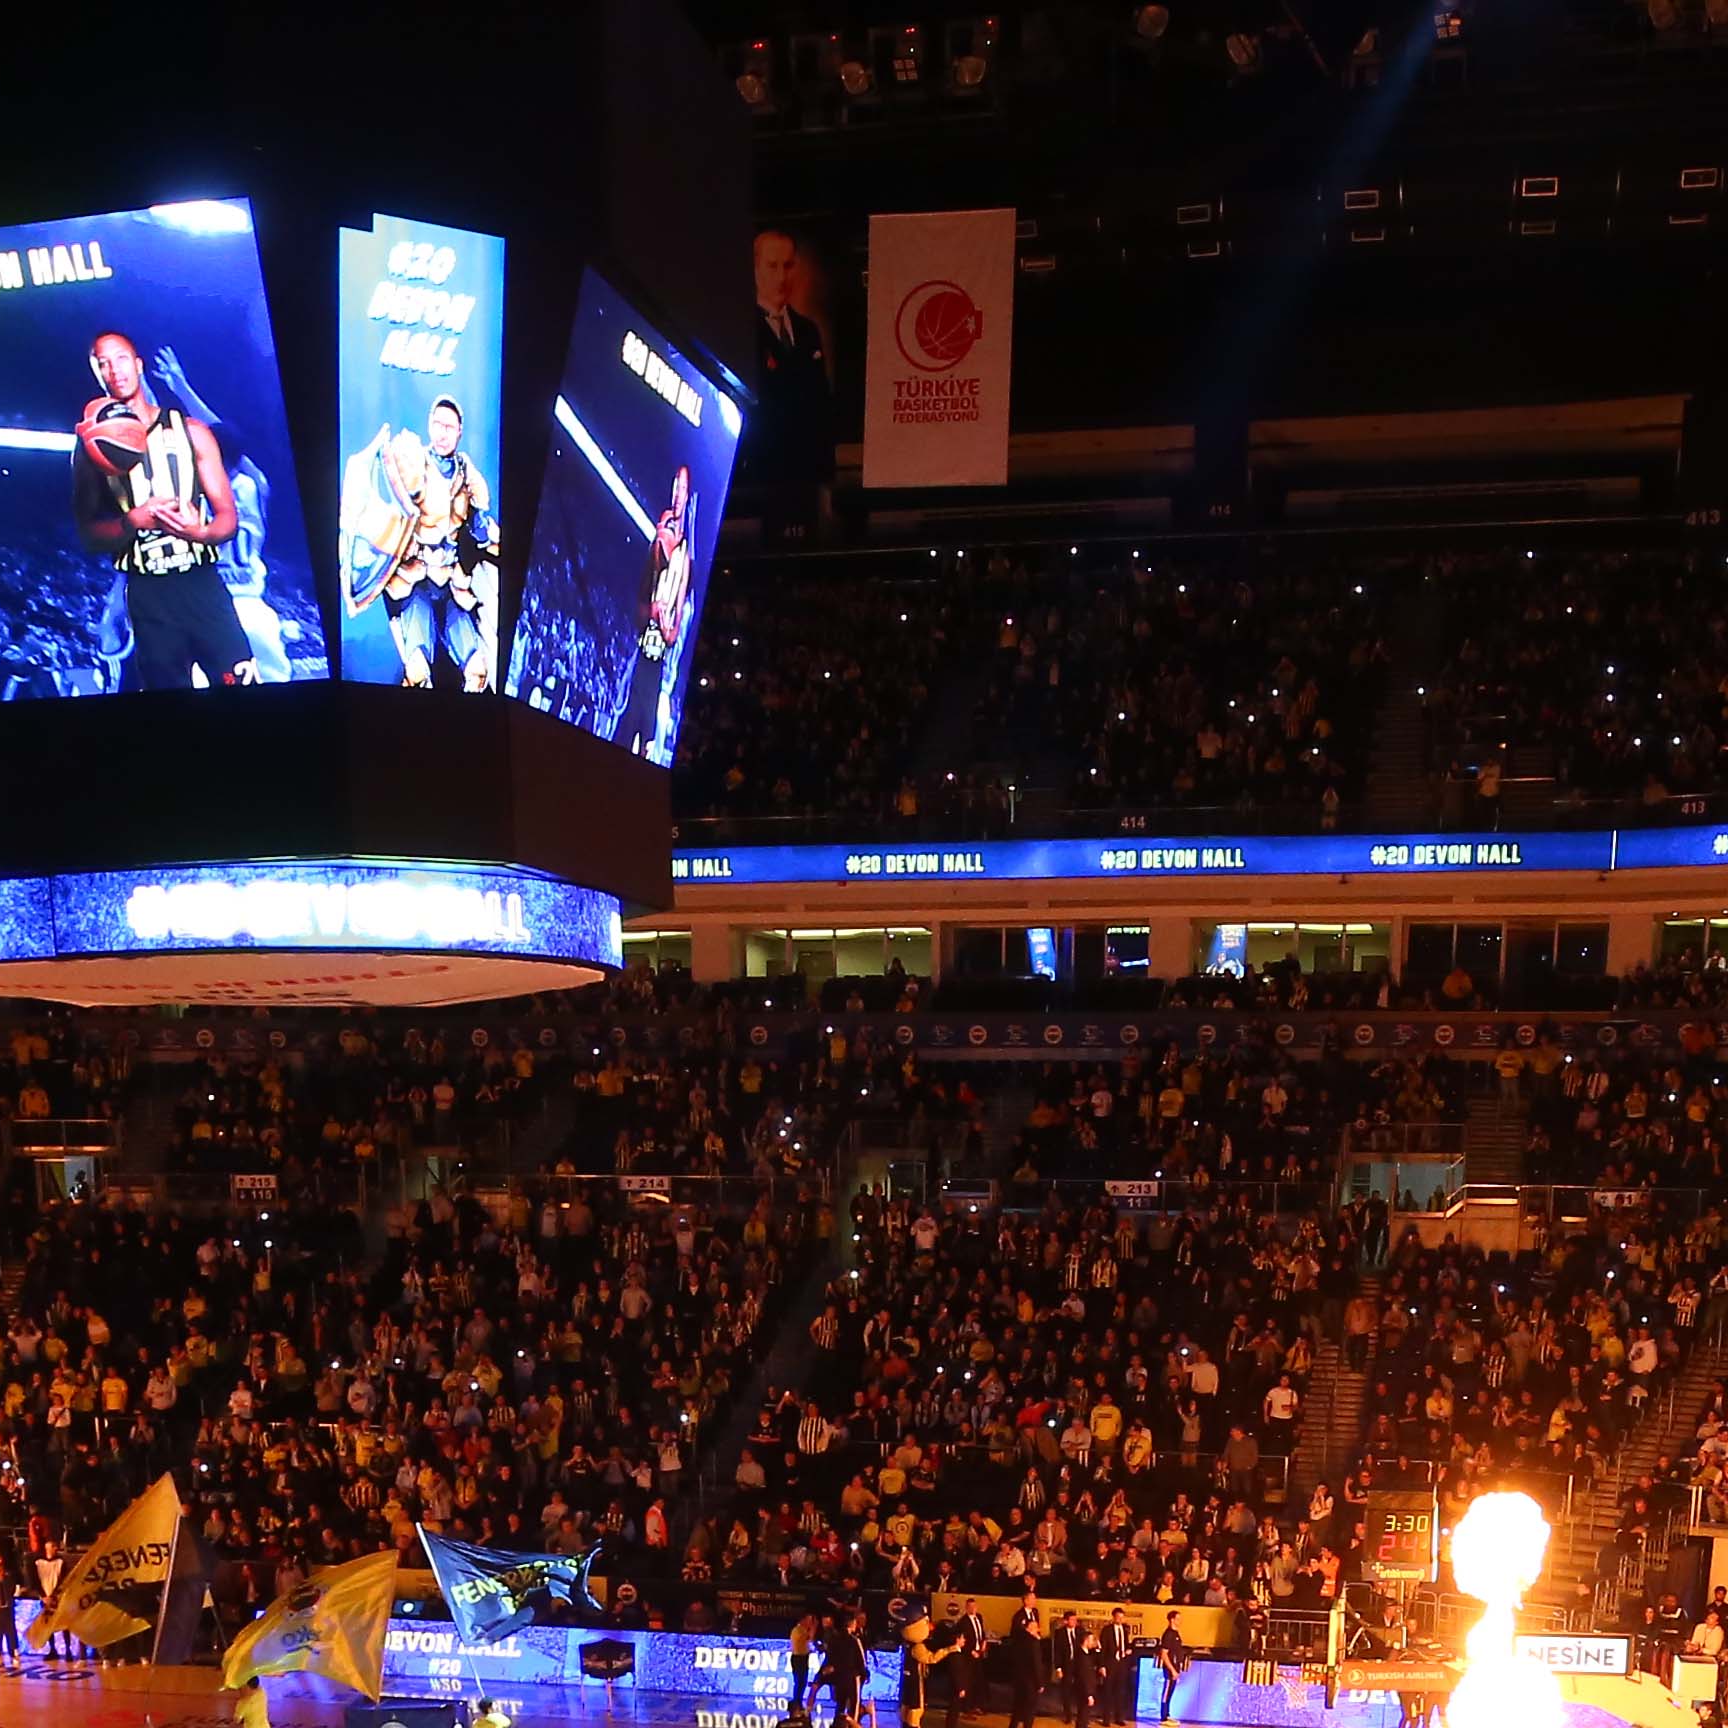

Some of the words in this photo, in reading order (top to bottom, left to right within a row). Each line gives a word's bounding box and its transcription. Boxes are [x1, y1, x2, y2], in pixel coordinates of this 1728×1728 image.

[27, 240, 113, 286] HALL
[893, 376, 980, 398] TÜRKİYE
[893, 397, 978, 411] BASKETBOL
[892, 411, 981, 424] FEDERASYONU
[1680, 800, 1705, 814] 413
[1120, 815, 1147, 829] 414
[846, 855, 881, 874] #20
[885, 854, 939, 874] DEVON
[943, 853, 984, 873] HALL
[1100, 850, 1137, 870] #20
[1141, 848, 1197, 869] DEVON
[1202, 848, 1245, 868] HALL
[1370, 845, 1409, 865] #20
[1413, 844, 1472, 865] DEVON
[1477, 844, 1521, 864] HALL
[692, 858, 732, 877] HALL
[639, 1178, 665, 1189] 214
[1127, 1183, 1152, 1195] 213
[1384, 1514, 1430, 1533] 3:30
[427, 1658, 462, 1676] #20
[694, 1647, 779, 1670] DEVON
[1365, 1669, 1403, 1682] TURKISH
[1405, 1669, 1446, 1682] AIRLINES
[752, 1677, 789, 1696] #20
